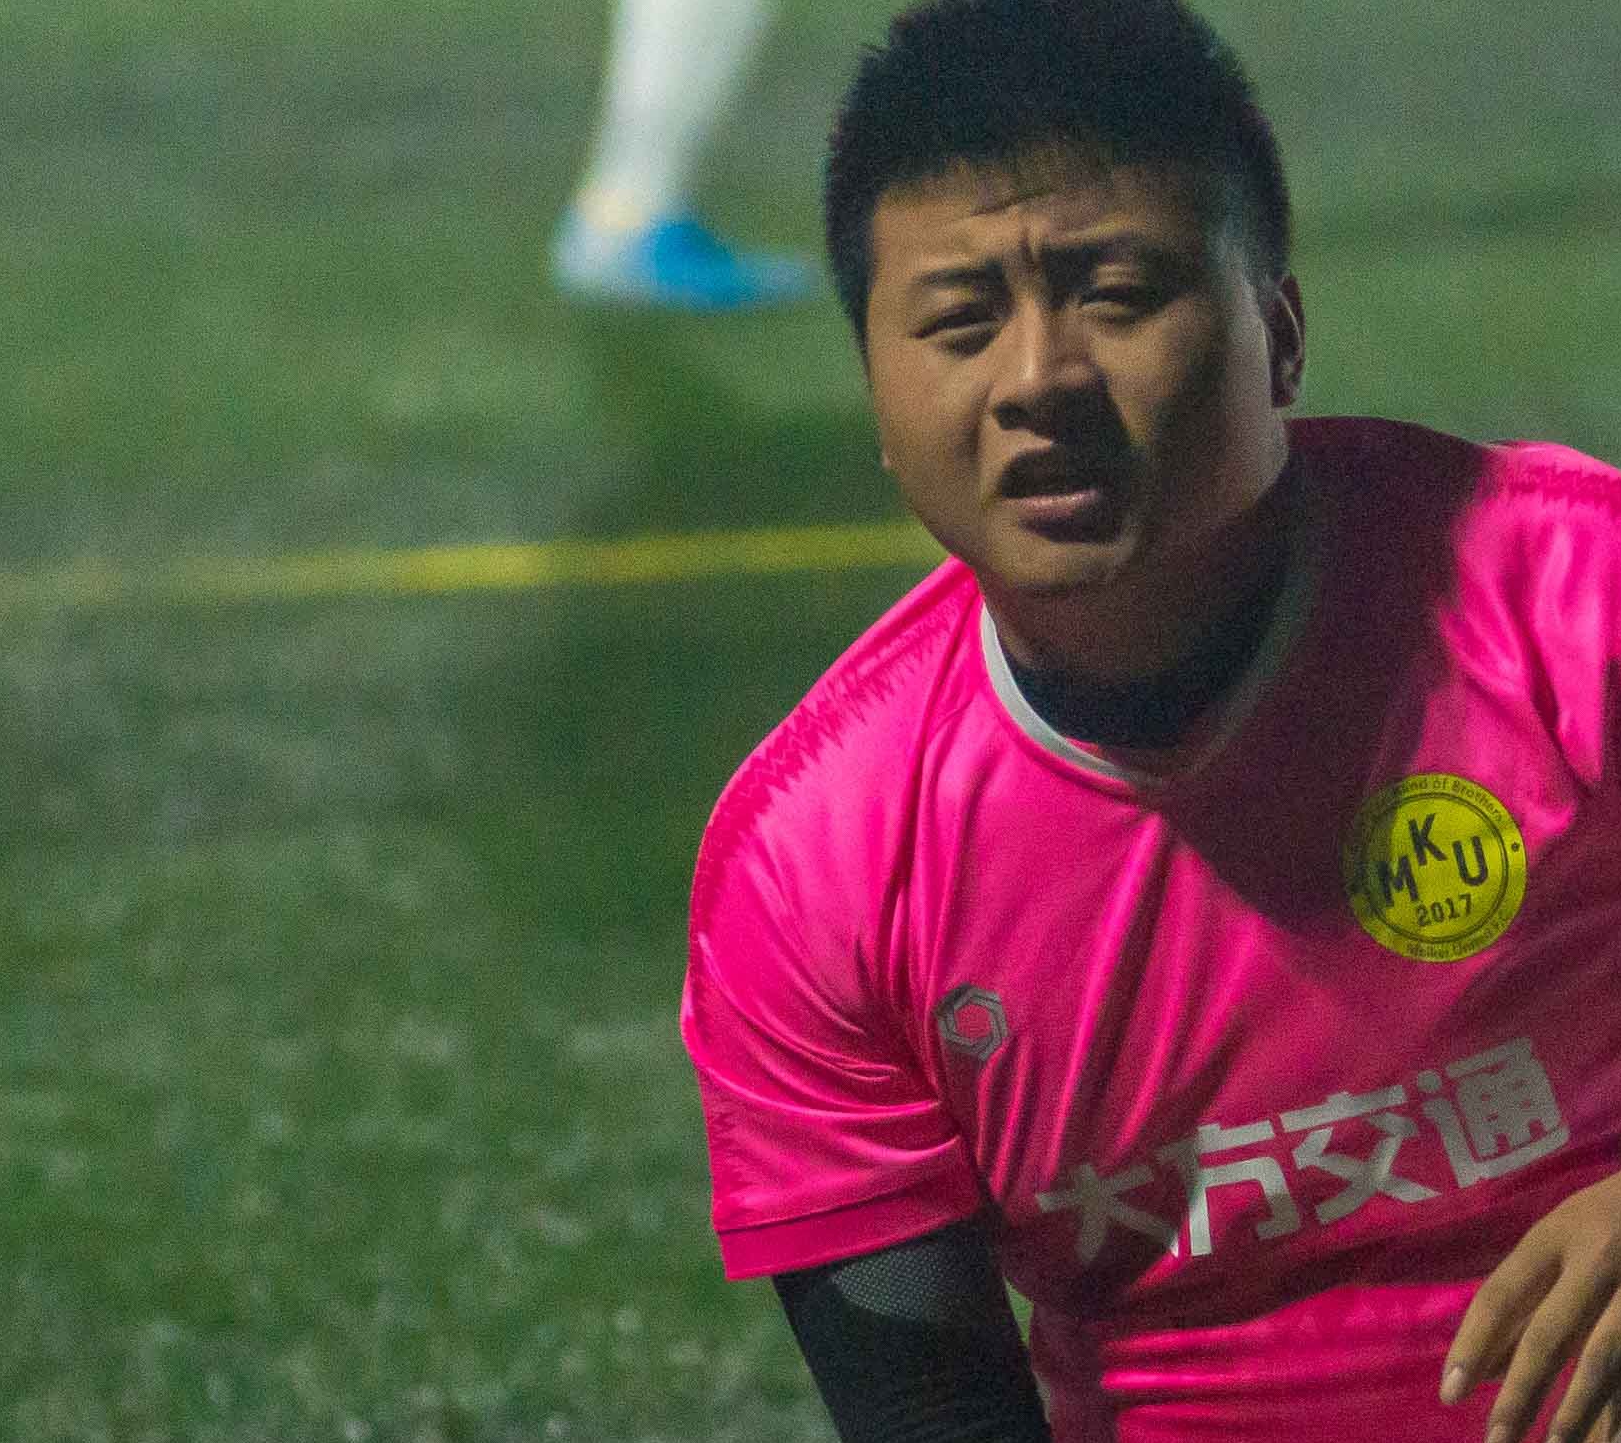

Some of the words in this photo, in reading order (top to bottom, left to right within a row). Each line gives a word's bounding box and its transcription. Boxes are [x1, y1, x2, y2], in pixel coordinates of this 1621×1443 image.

[1432, 779, 1447, 790] of
[1451, 779, 1503, 822] Brothers
[1378, 812, 1489, 908] MKU
[1416, 893, 1472, 927] 2017
[1035, 1036, 1571, 1263] 大方交通
